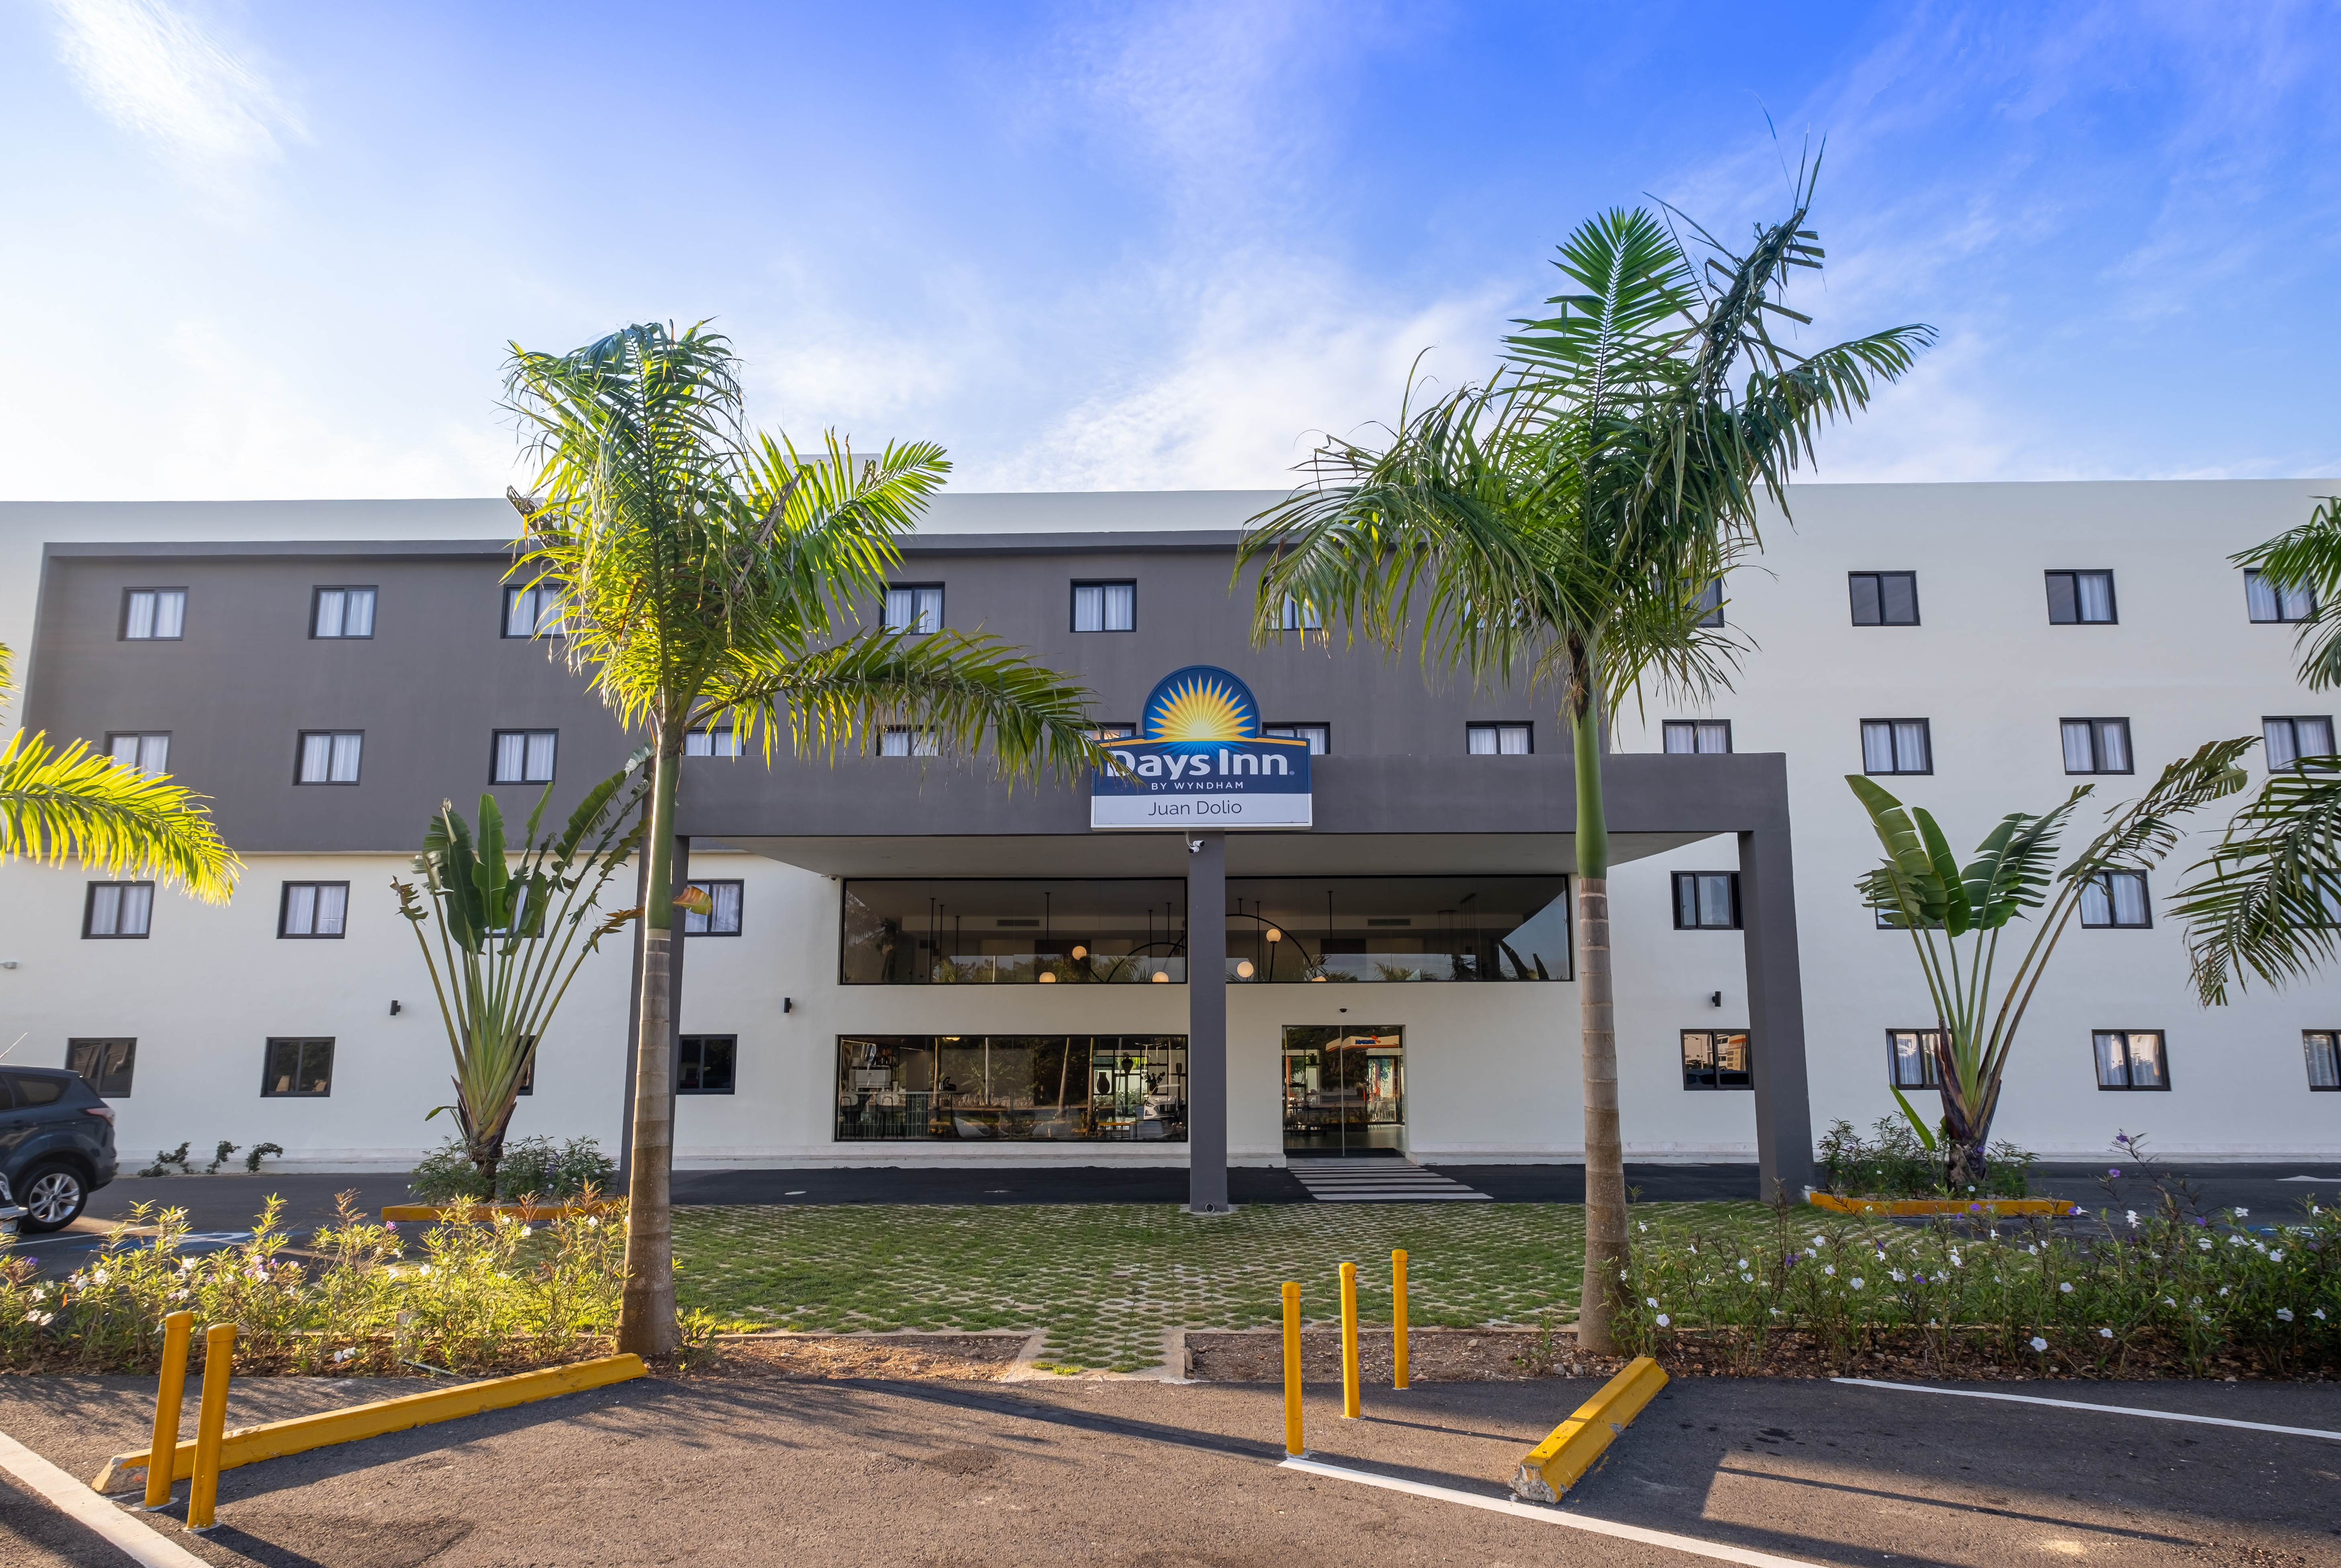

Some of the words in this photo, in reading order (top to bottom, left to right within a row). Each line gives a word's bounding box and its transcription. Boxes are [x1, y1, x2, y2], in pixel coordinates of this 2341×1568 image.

[1107, 750, 1210, 780] Days
[1219, 748, 1288, 775] Inn
[1174, 781, 1244, 790] WYNDHAM
[1148, 801, 1190, 816] Juan
[1197, 800, 1242, 814] Dolio
